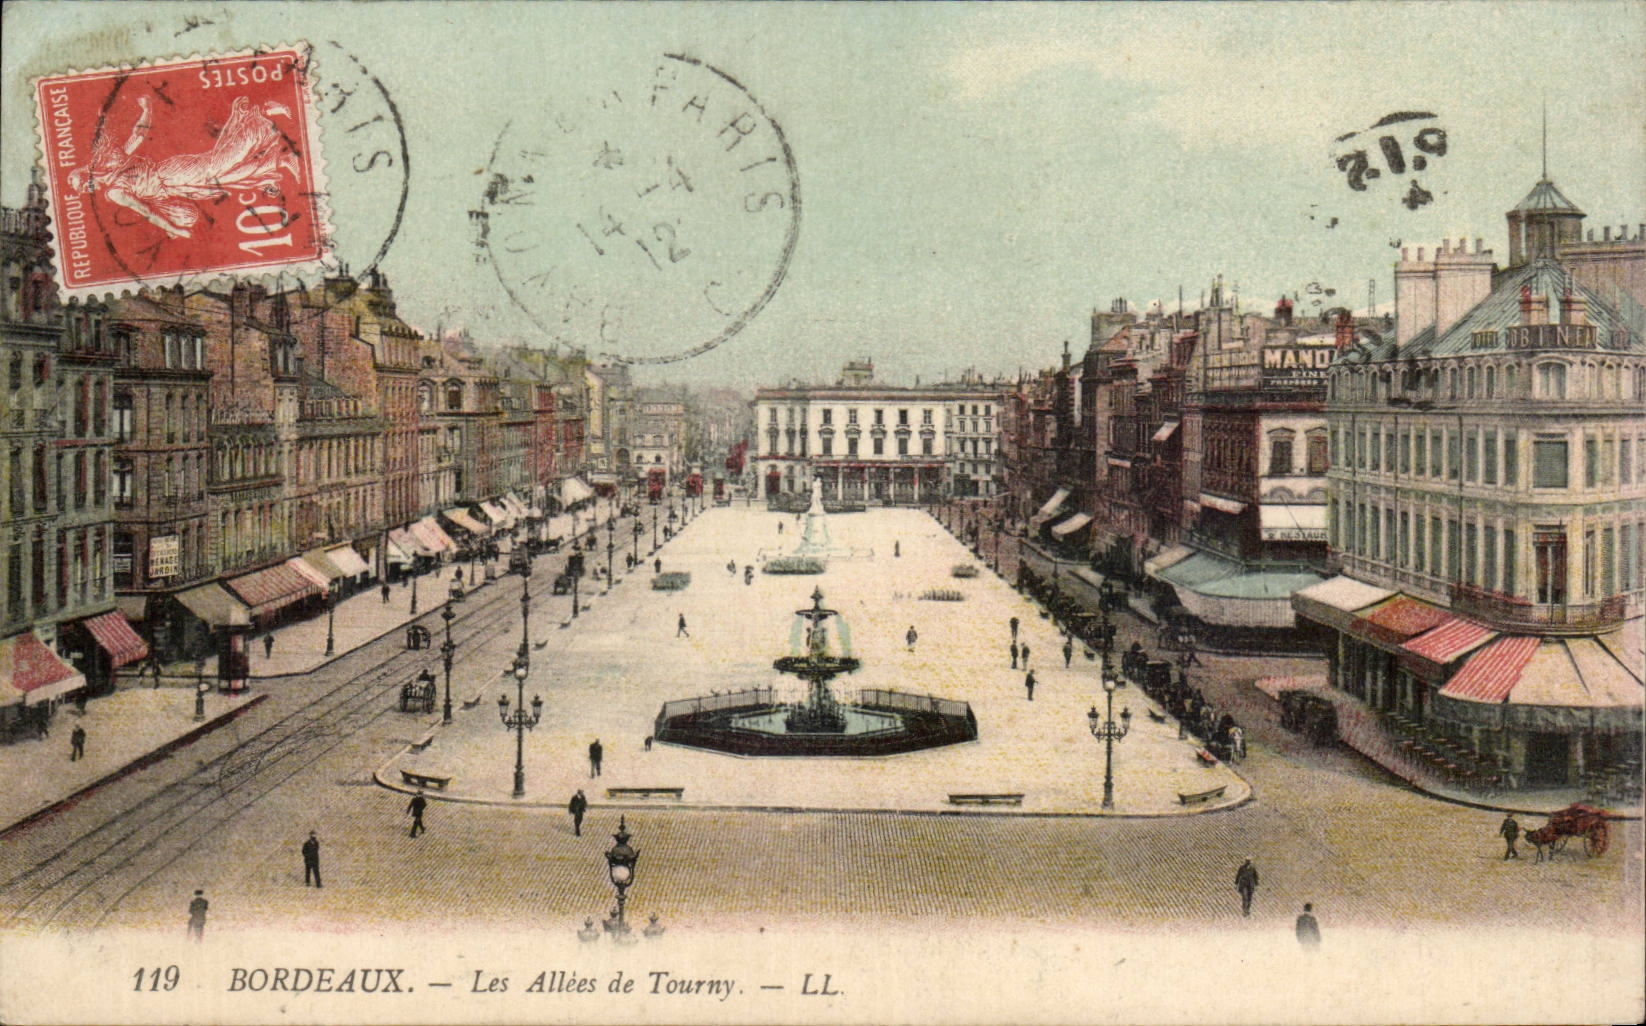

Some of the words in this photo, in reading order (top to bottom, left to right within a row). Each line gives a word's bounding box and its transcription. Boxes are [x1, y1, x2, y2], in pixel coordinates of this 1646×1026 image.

[198, 64, 283, 89] POSTES
[50, 86, 76, 168] FRANÇAISE
[65, 193, 92, 280] REPUBLIQUE
[1280, 531, 1328, 540] RESTAUR
